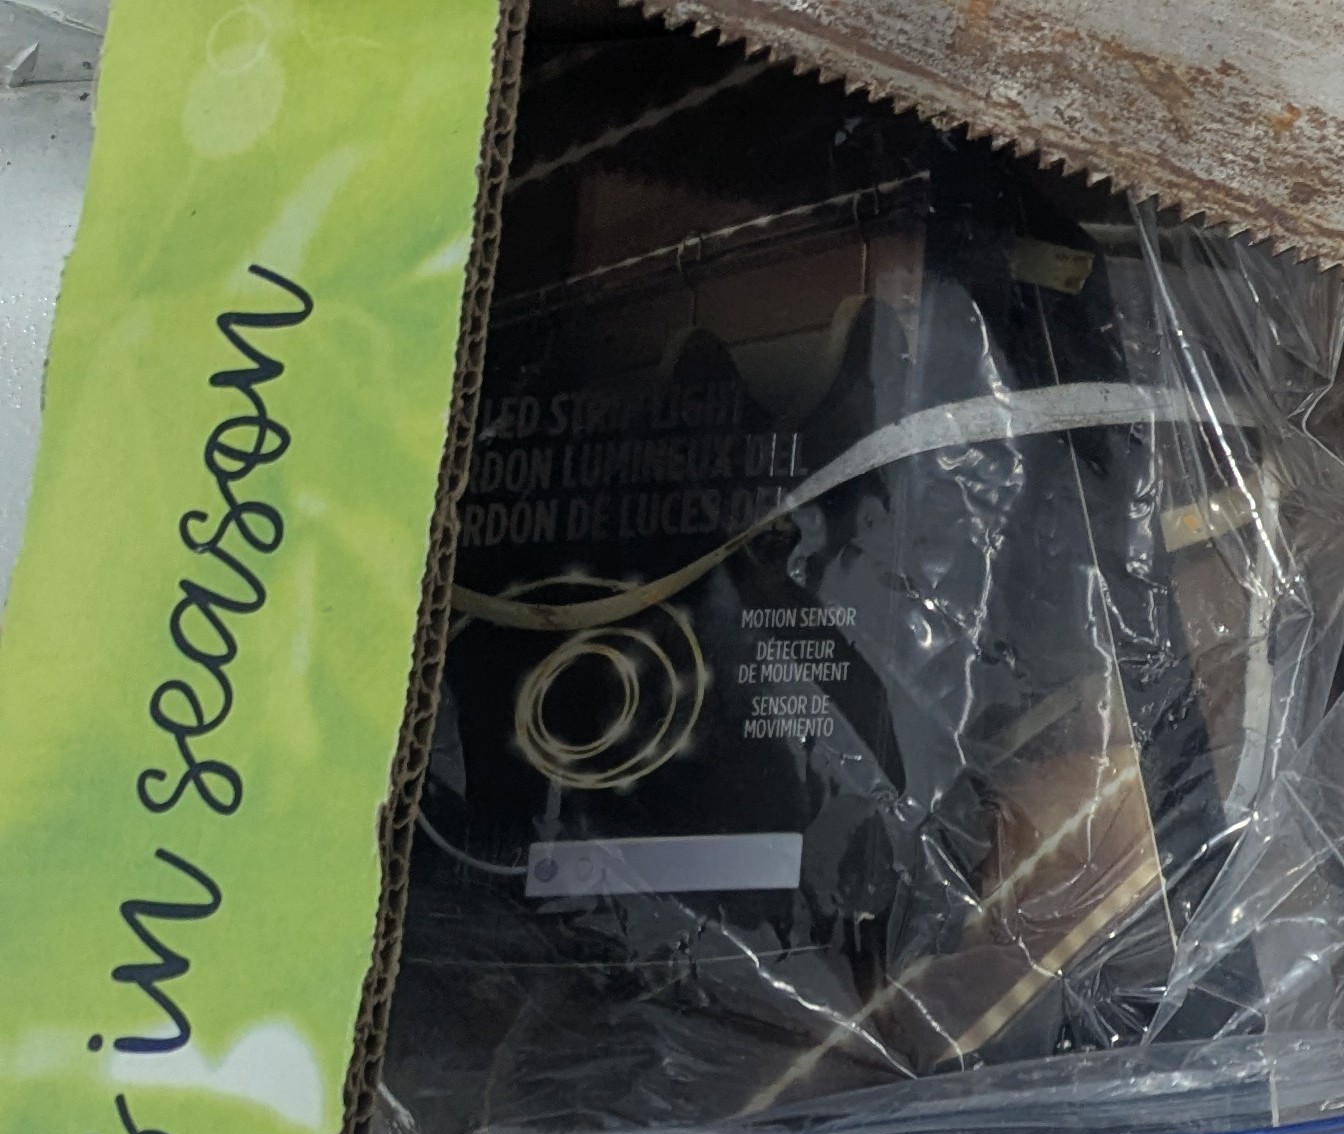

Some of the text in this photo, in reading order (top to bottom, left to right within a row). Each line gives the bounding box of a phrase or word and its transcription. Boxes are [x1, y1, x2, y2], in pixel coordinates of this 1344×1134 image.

[137, 263, 314, 817] season
[740, 604, 858, 631] MOTION SENSOR
[755, 632, 836, 664] DÉTECTEUR
[737, 659, 851, 686] DE MOUVEMENT
[749, 692, 831, 718] SENSOR DE
[741, 713, 835, 741] MOVIMIENTO
[86, 847, 226, 1054] in
